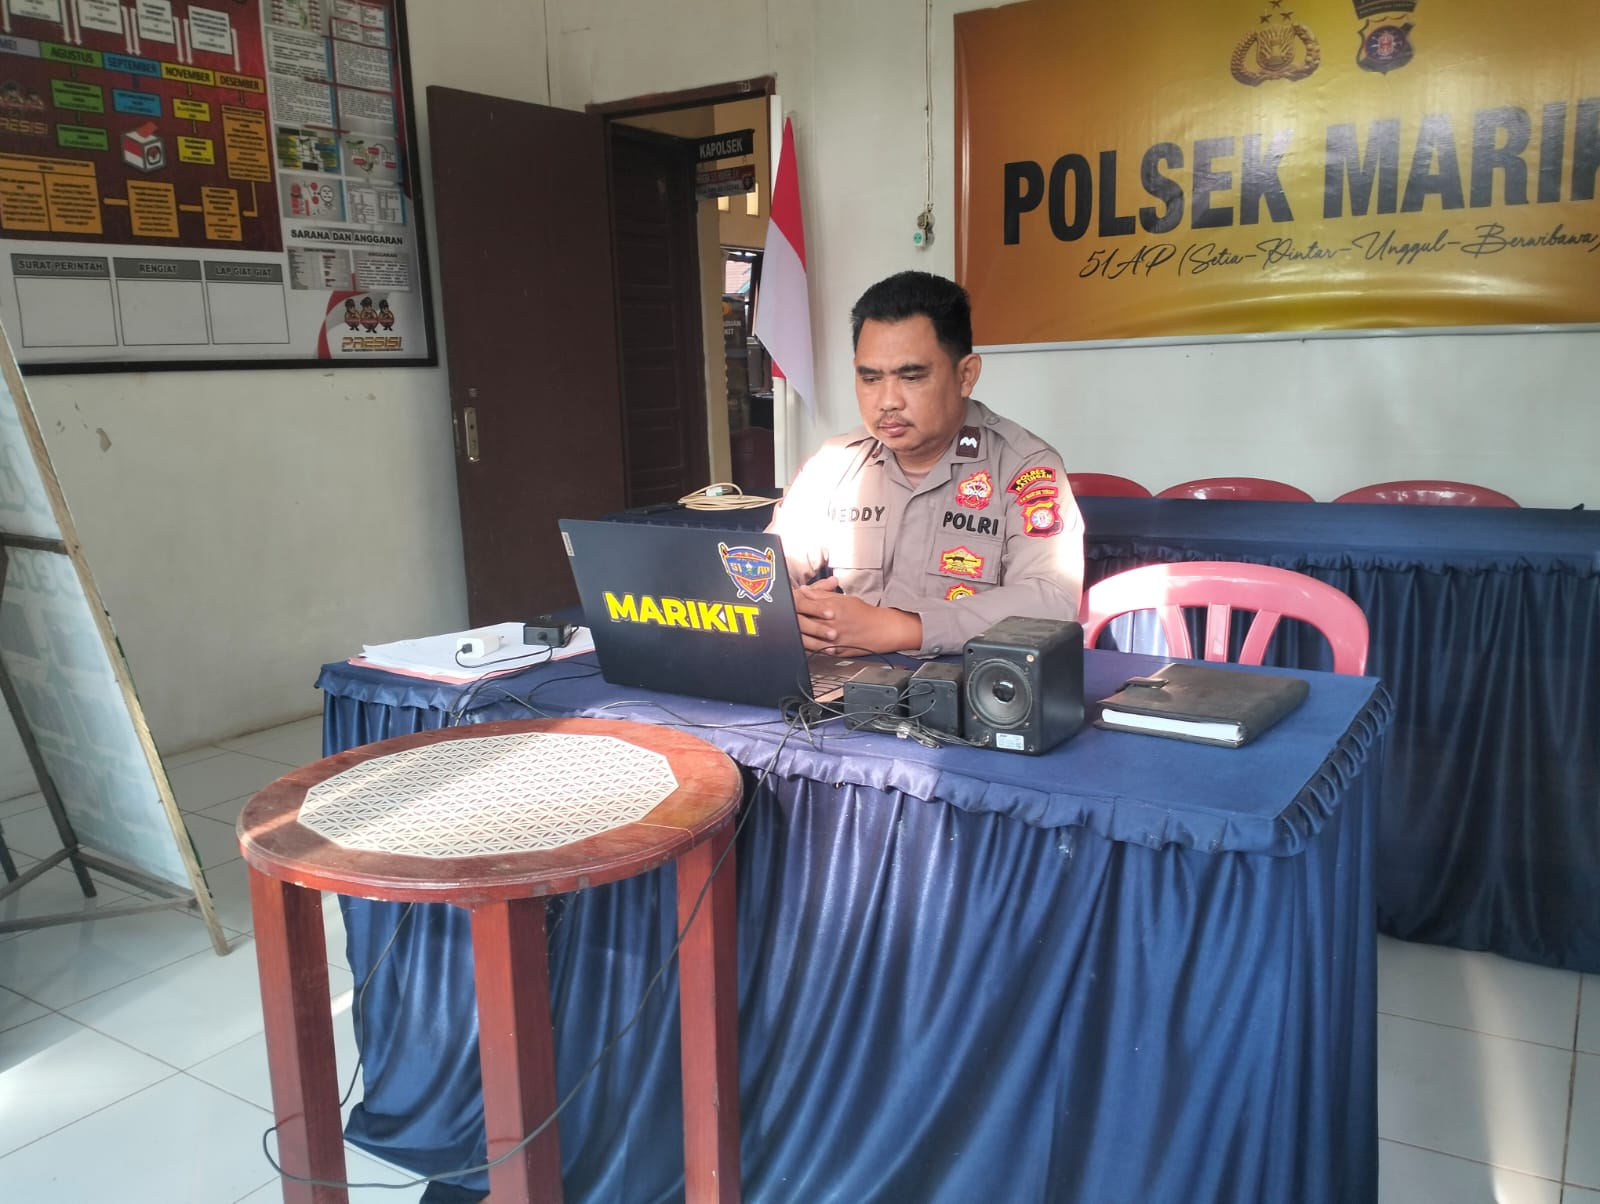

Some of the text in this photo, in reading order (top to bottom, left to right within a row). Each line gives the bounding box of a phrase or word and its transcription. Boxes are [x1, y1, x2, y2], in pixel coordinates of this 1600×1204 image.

[51, 48, 94, 63] AGUSTUS
[107, 56, 157, 74] SEPTEMBER
[165, 66, 211, 83] NOVEMBER
[219, 75, 259, 90] DESEMBER
[699, 137, 744, 159] KAPOLSEK
[1003, 129, 1295, 246] POLSEK
[291, 229, 403, 245] SARANA DAN ANGGARAN
[18, 260, 104, 271] SURAT PERINTAH
[139, 263, 177, 274] RENGIAT
[341, 336, 402, 348] PRESISI
[1015, 469, 1046, 485] POLRES
[829, 505, 886, 523] EDDY
[943, 511, 998, 536] POLRI
[604, 592, 759, 635] MARIKIT
